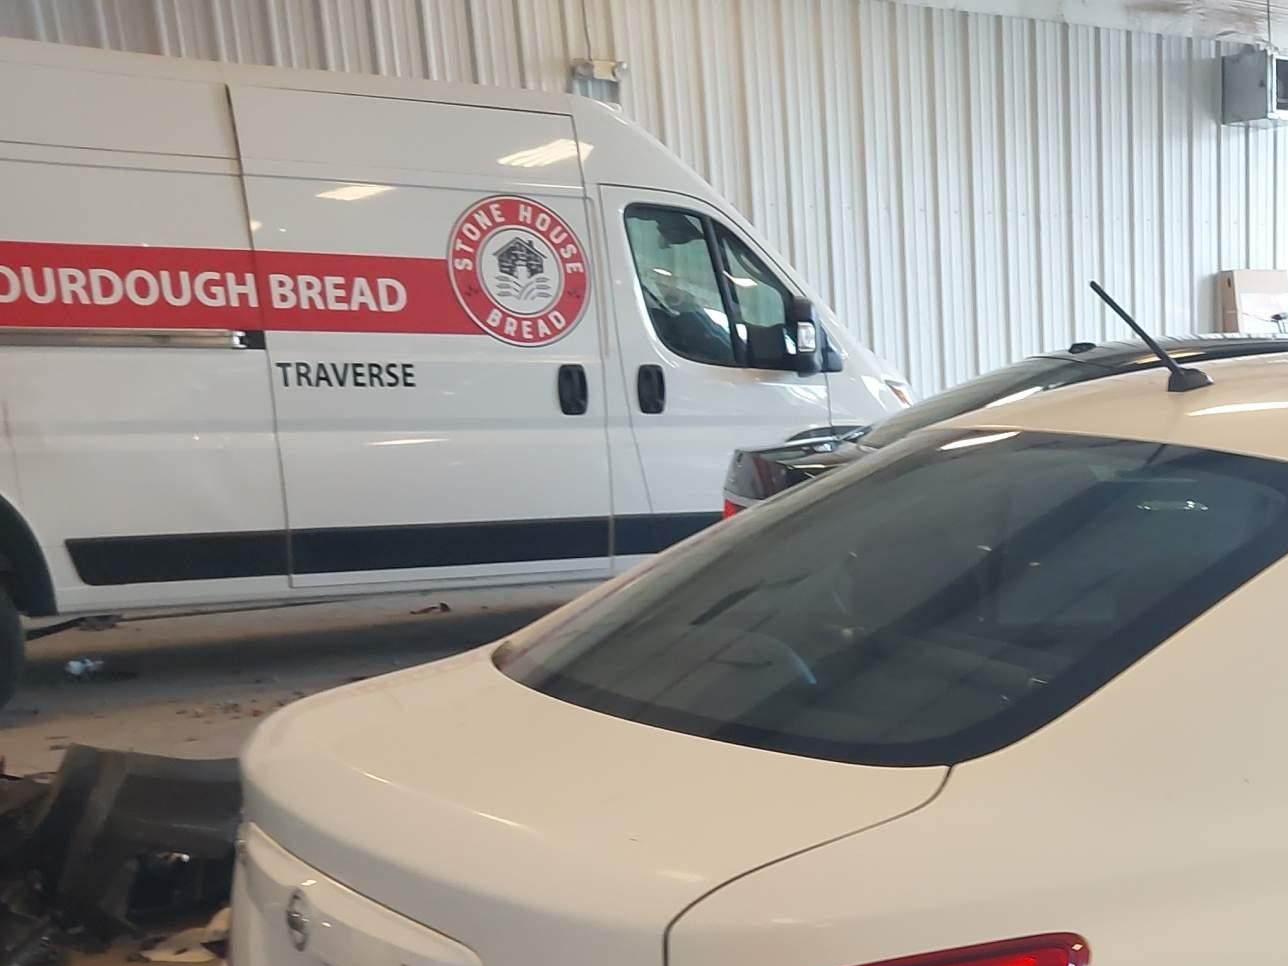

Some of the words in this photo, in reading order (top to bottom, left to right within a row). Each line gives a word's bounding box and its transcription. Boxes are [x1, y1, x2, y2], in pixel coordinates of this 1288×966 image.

[453, 203, 506, 272] STONE
[518, 203, 584, 274] HOUSE
[269, 274, 407, 312] BREAD
[486, 308, 567, 339] BREAD
[275, 361, 416, 388] TRAVERSE
